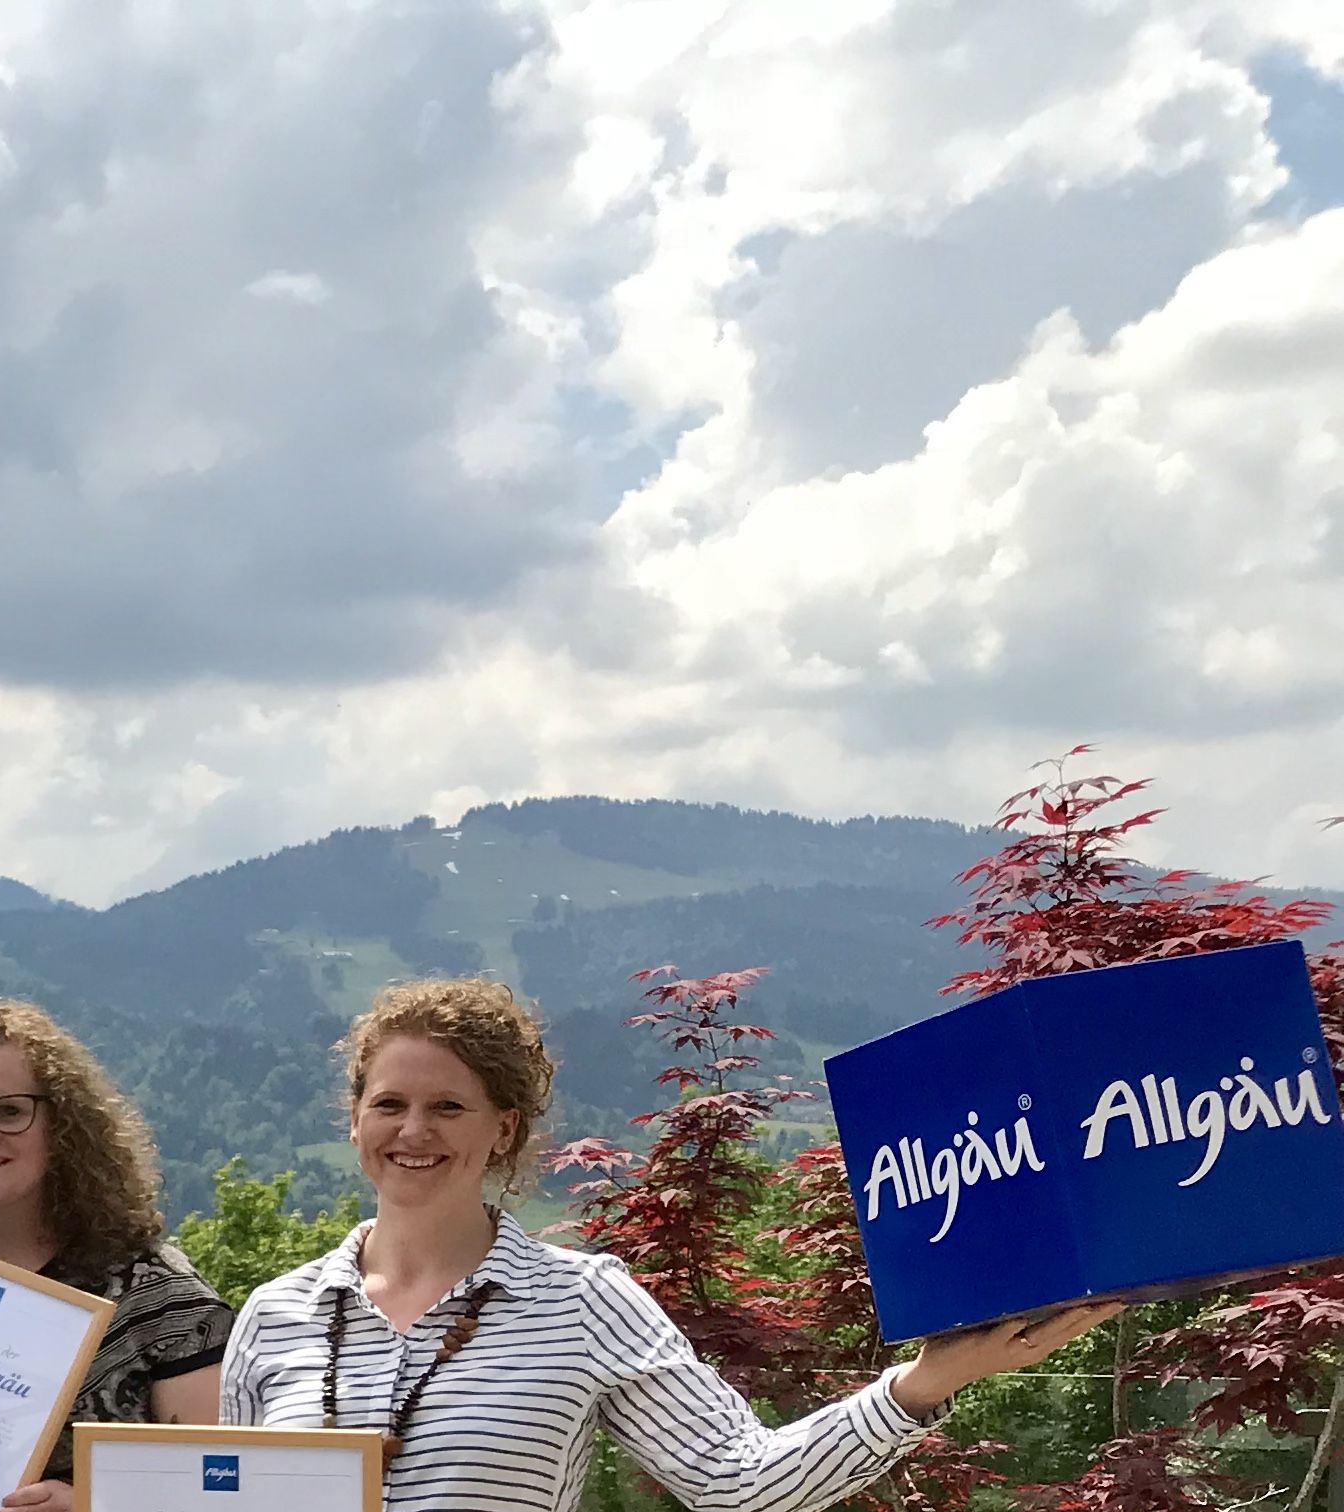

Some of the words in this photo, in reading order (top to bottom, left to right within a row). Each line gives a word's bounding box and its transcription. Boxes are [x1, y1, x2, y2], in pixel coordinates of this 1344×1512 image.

[863, 1110, 1046, 1243] Allgäu
[1080, 1056, 1332, 1188] Allgäu
[0, 1342, 21, 1360] der
